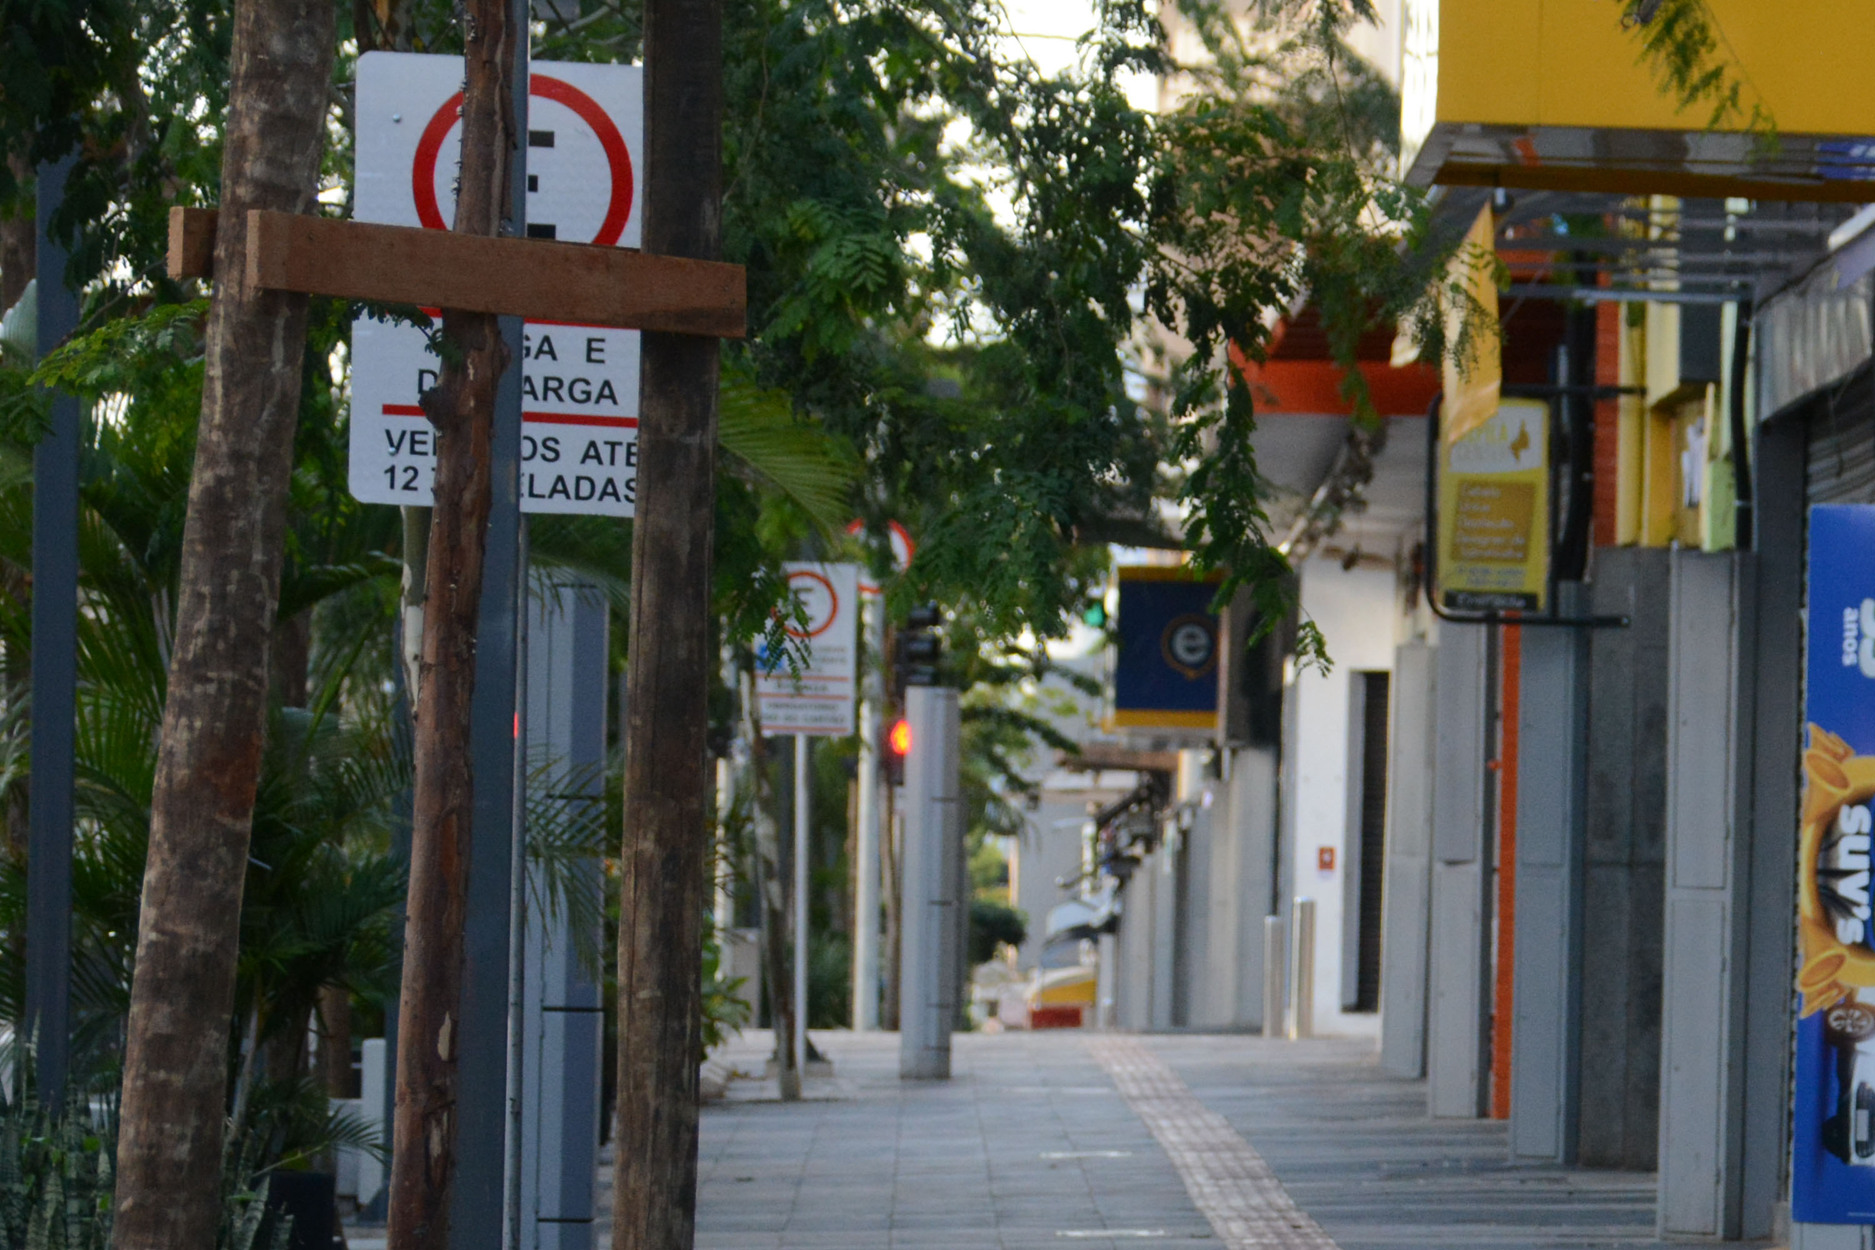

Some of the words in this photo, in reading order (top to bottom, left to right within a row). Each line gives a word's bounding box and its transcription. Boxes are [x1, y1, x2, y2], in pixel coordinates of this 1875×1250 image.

[418, 369, 618, 405] DARGA
[383, 465, 419, 491] 12
[1841, 606, 1858, 668] anos
